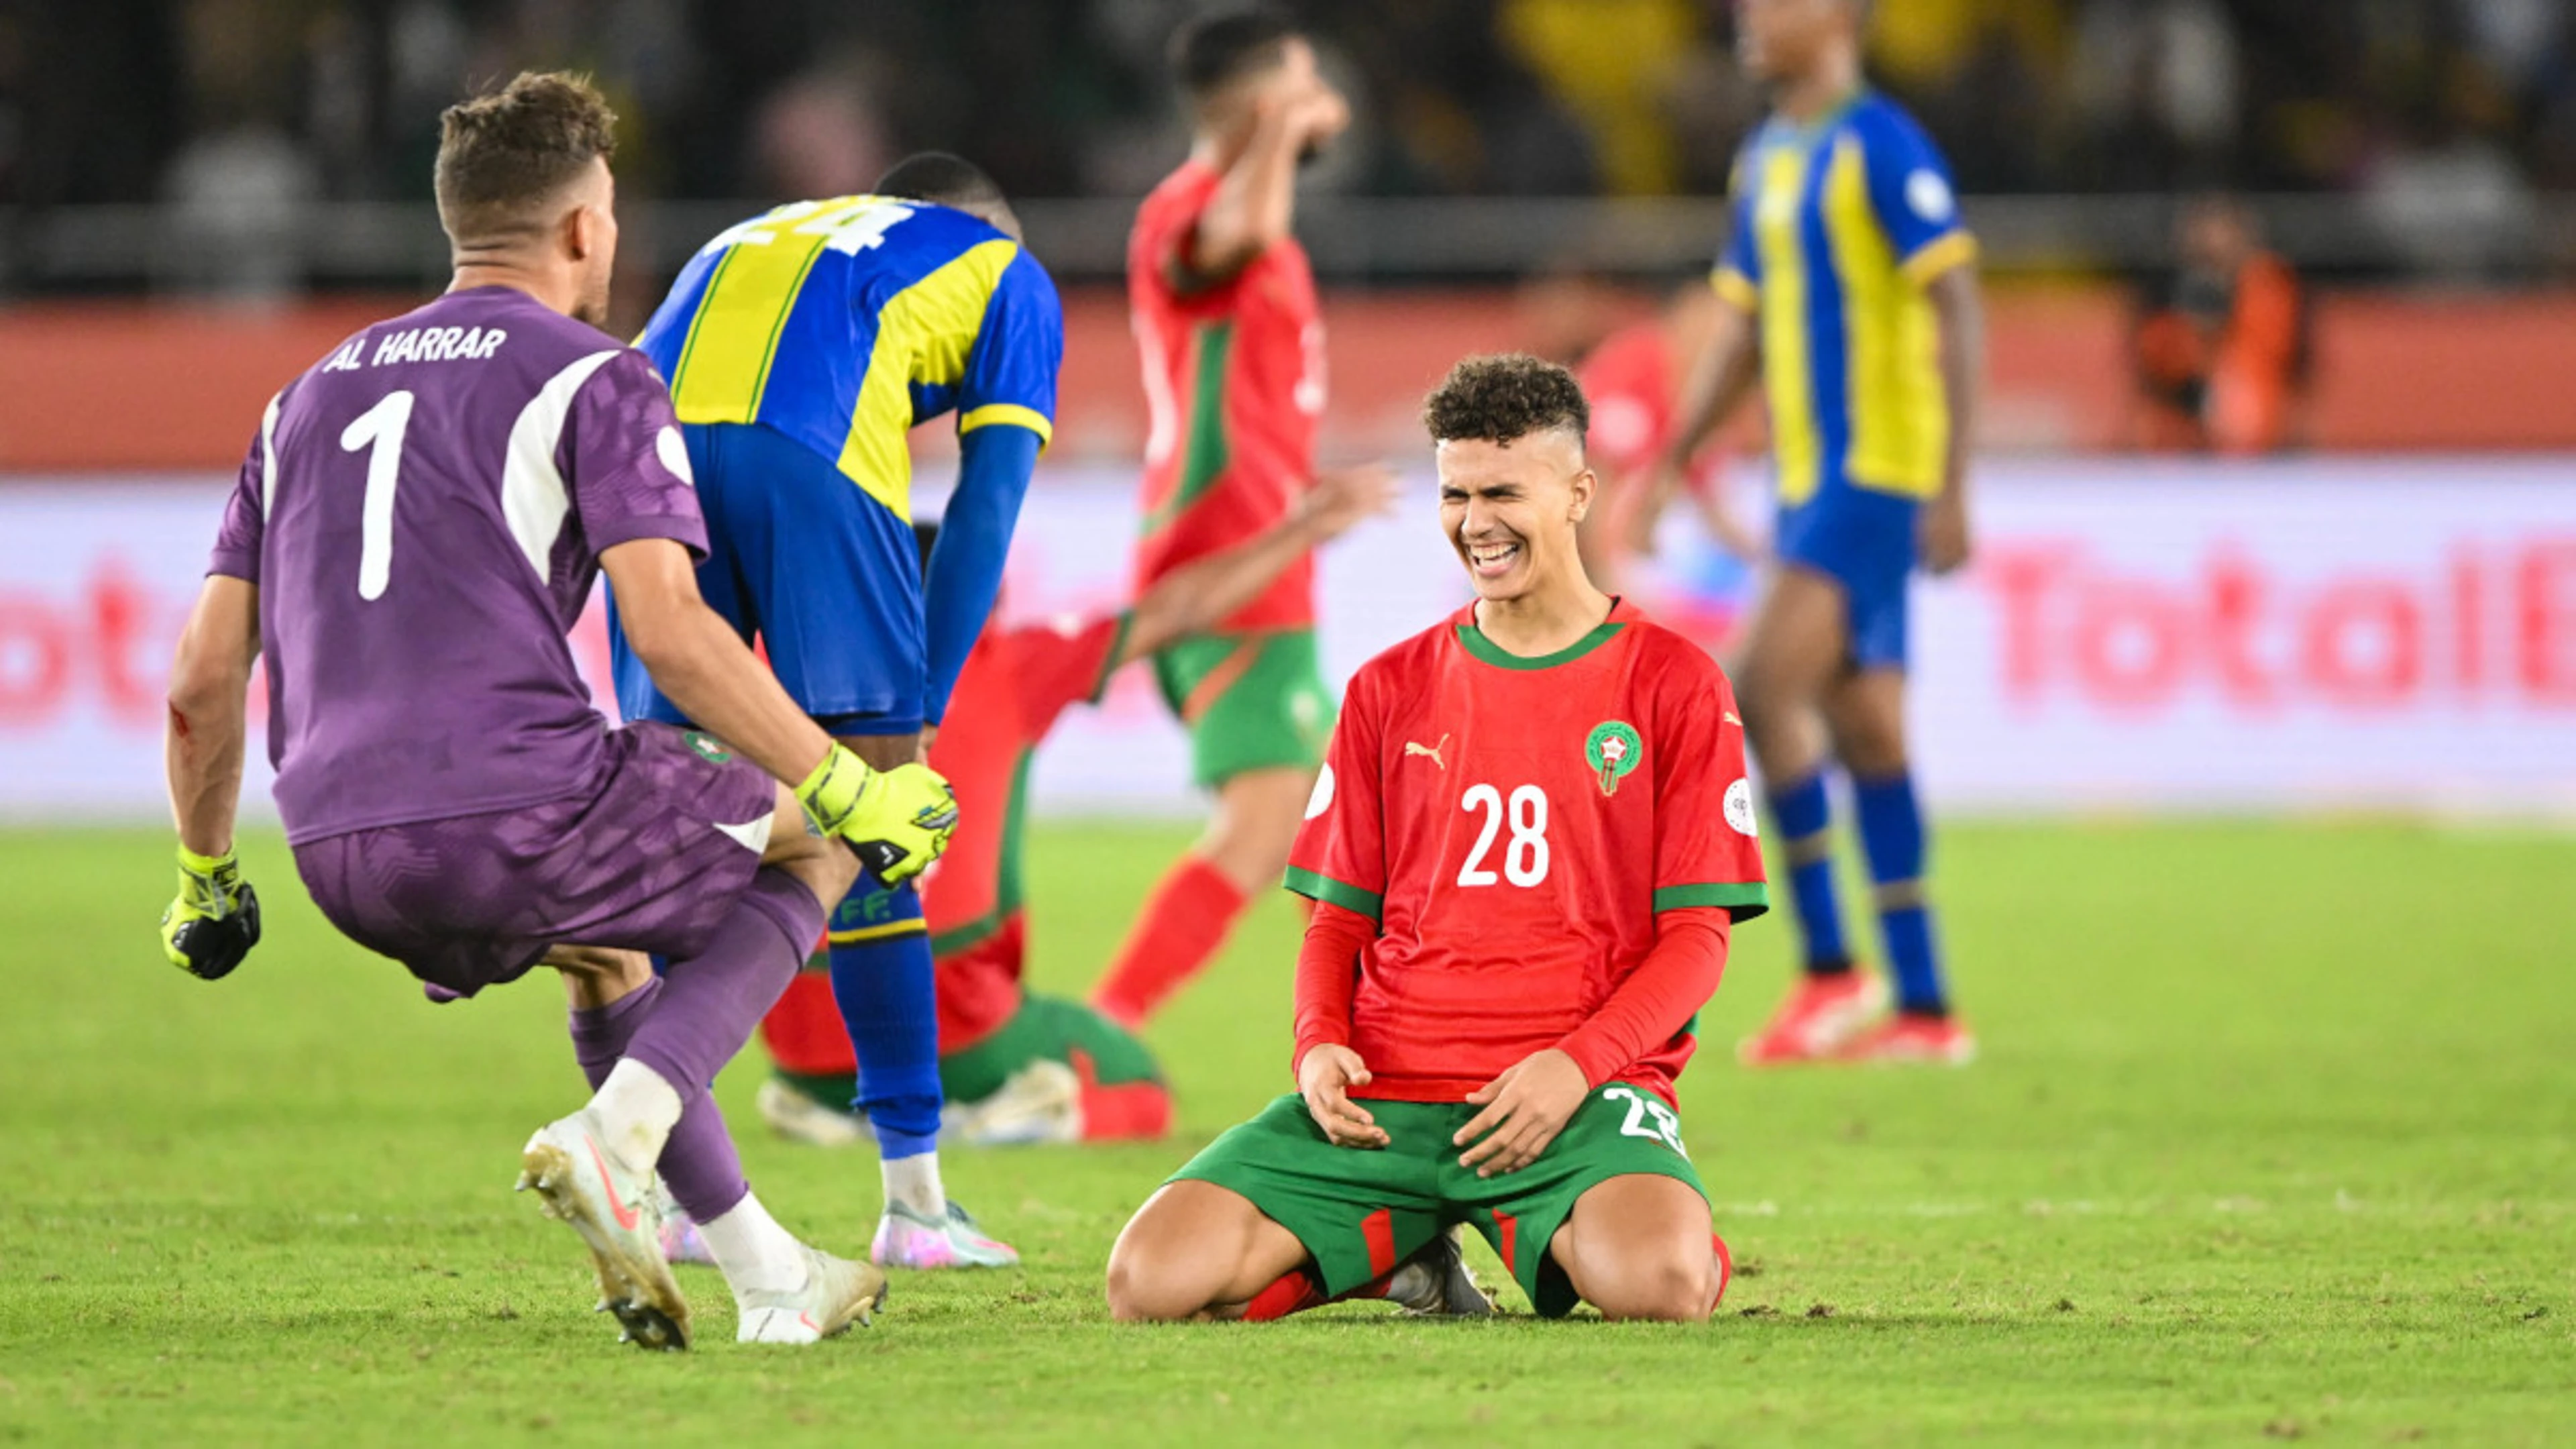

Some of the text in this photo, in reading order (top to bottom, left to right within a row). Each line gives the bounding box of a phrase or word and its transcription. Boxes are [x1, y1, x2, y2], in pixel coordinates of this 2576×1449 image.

[704, 199, 916, 257] 24
[322, 326, 507, 374] AL HARRAR
[339, 390, 415, 601] 1
[0, 549, 181, 729] ot
[1456, 783, 1550, 888] 28
[829, 885, 900, 924] FF.
[1603, 1087, 1689, 1160] 28
